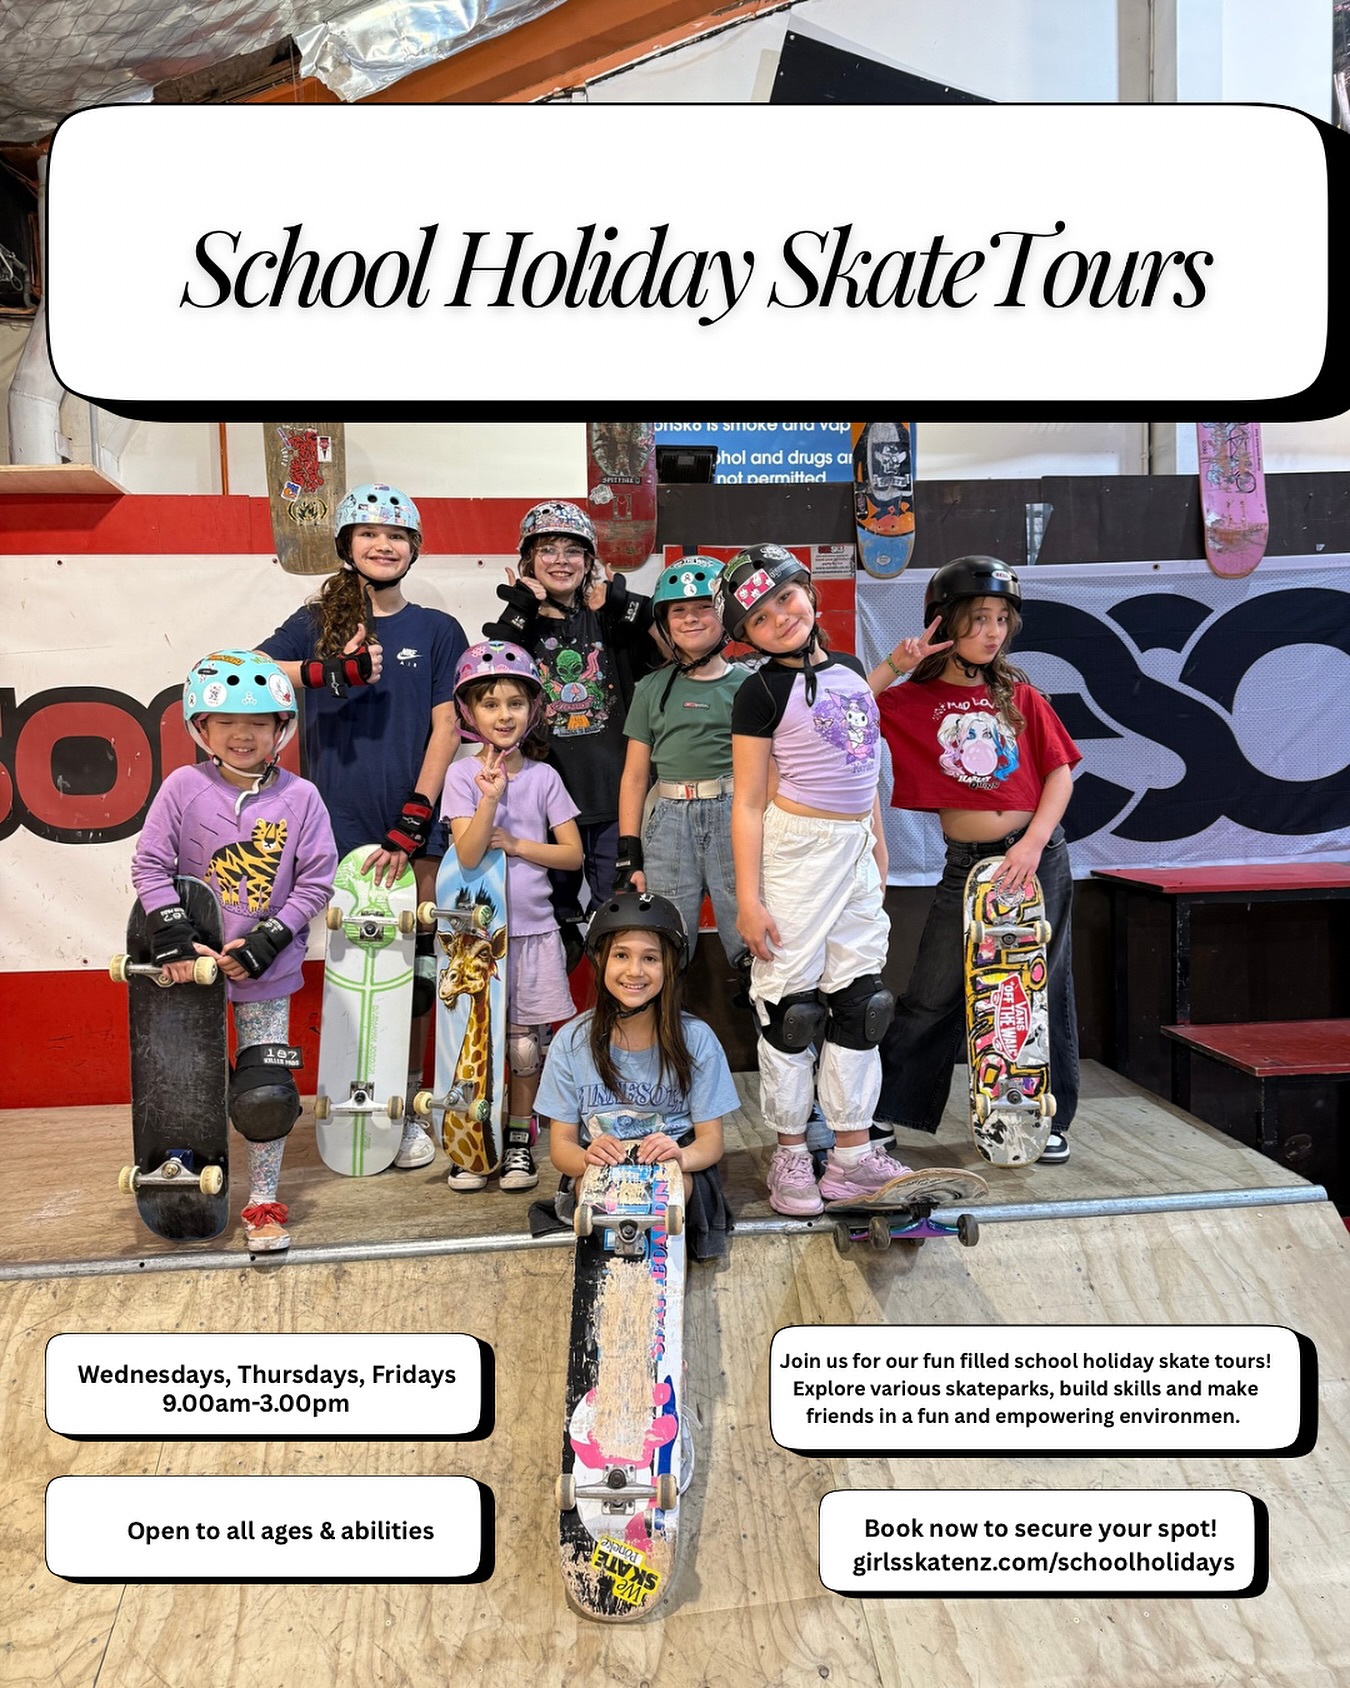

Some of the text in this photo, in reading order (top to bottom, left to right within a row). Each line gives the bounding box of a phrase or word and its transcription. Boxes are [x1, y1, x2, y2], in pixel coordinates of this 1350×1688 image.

[722, 422, 778, 432] smoke
[822, 422, 851, 434] vap
[715, 449, 853, 468] hol and drugs ar
[717, 472, 826, 484] not permitted
[947, 701, 970, 711] MAD
[1000, 1005, 1015, 1026] THE
[1015, 1001, 1029, 1031] VANS
[266, 1048, 298, 1060] 187
[594, 1550, 659, 1591] SKATE
[617, 1579, 642, 1603] We
